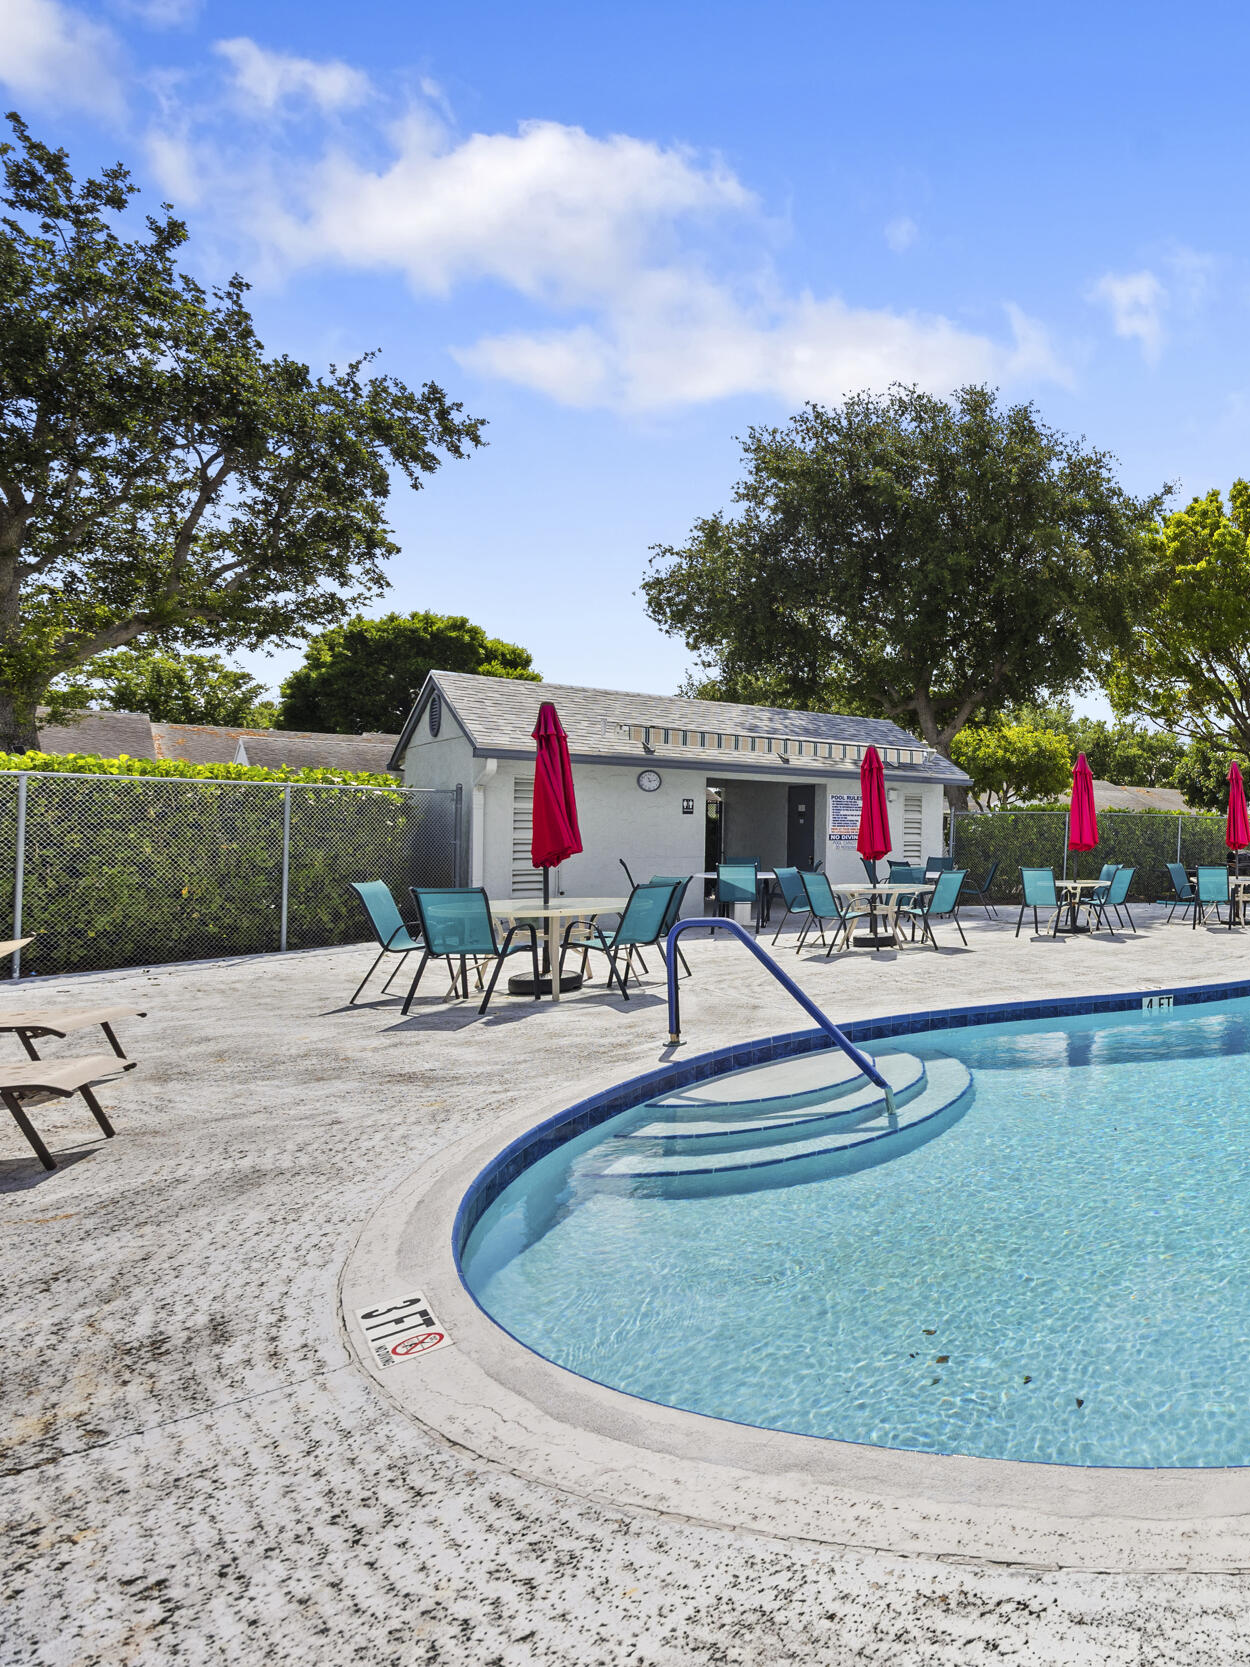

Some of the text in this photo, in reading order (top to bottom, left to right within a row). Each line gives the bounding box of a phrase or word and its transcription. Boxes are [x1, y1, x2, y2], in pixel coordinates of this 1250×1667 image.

[1159, 997, 1172, 1008] FT
[360, 1298, 436, 1342] 3 FT
